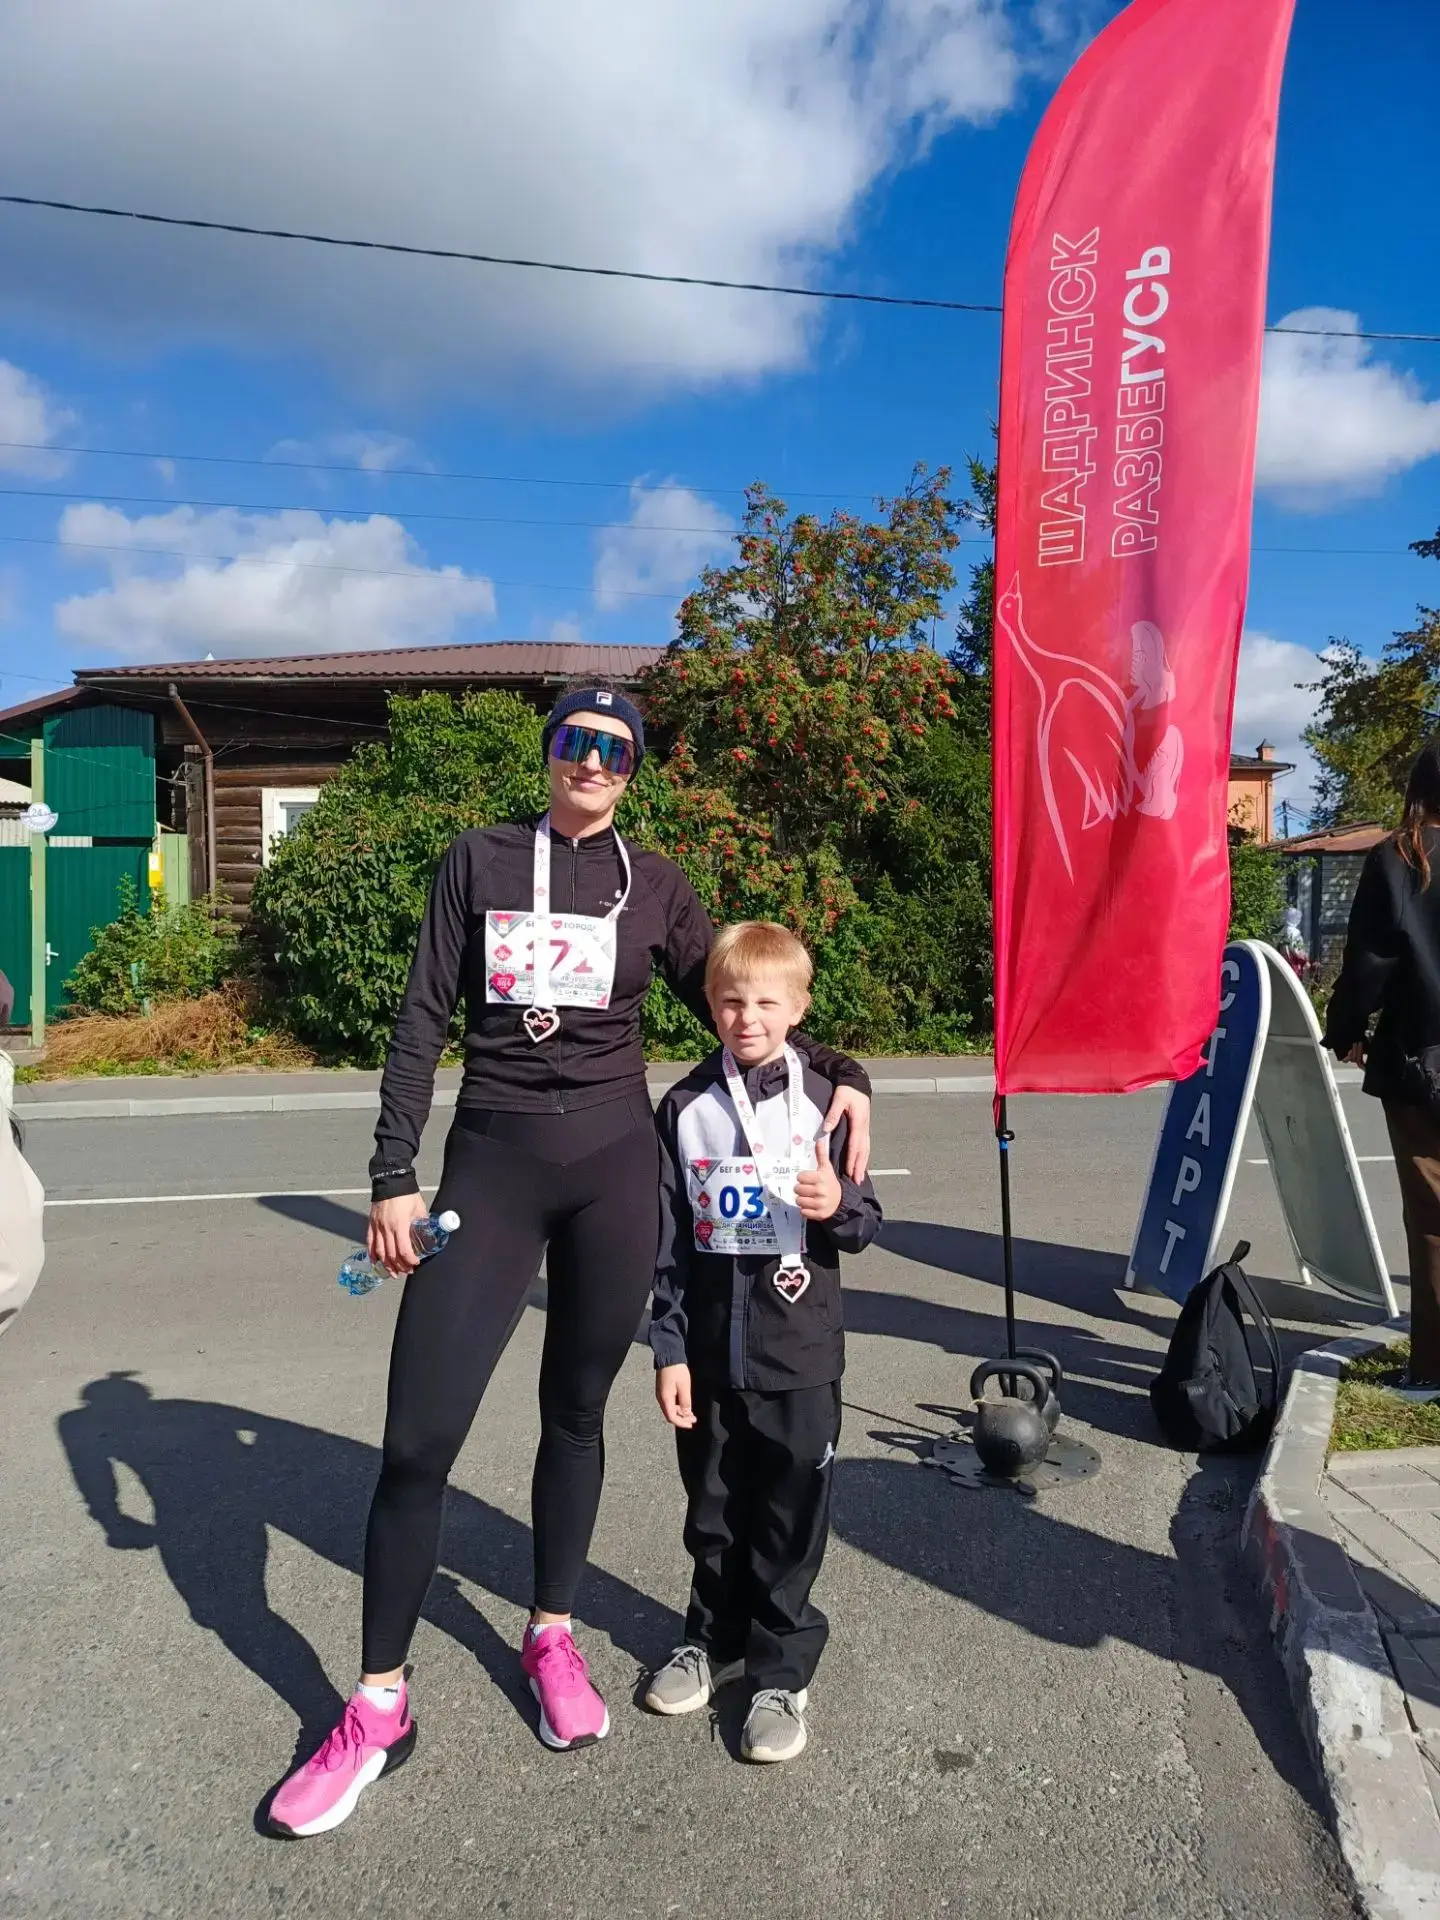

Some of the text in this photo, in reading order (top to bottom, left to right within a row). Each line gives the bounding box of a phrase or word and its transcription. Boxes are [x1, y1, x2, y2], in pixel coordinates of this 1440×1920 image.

[1038, 227, 1100, 566] ШАДРИНСК
[1111, 246, 1171, 557] РАЗБЕГУСЬ
[564, 921, 596, 932] ГОРОД
[719, 1185, 765, 1219] 03
[720, 1166, 733, 1174] БЕГ
[735, 1166, 741, 1174] В
[1159, 960, 1240, 1275] СТАРТ
